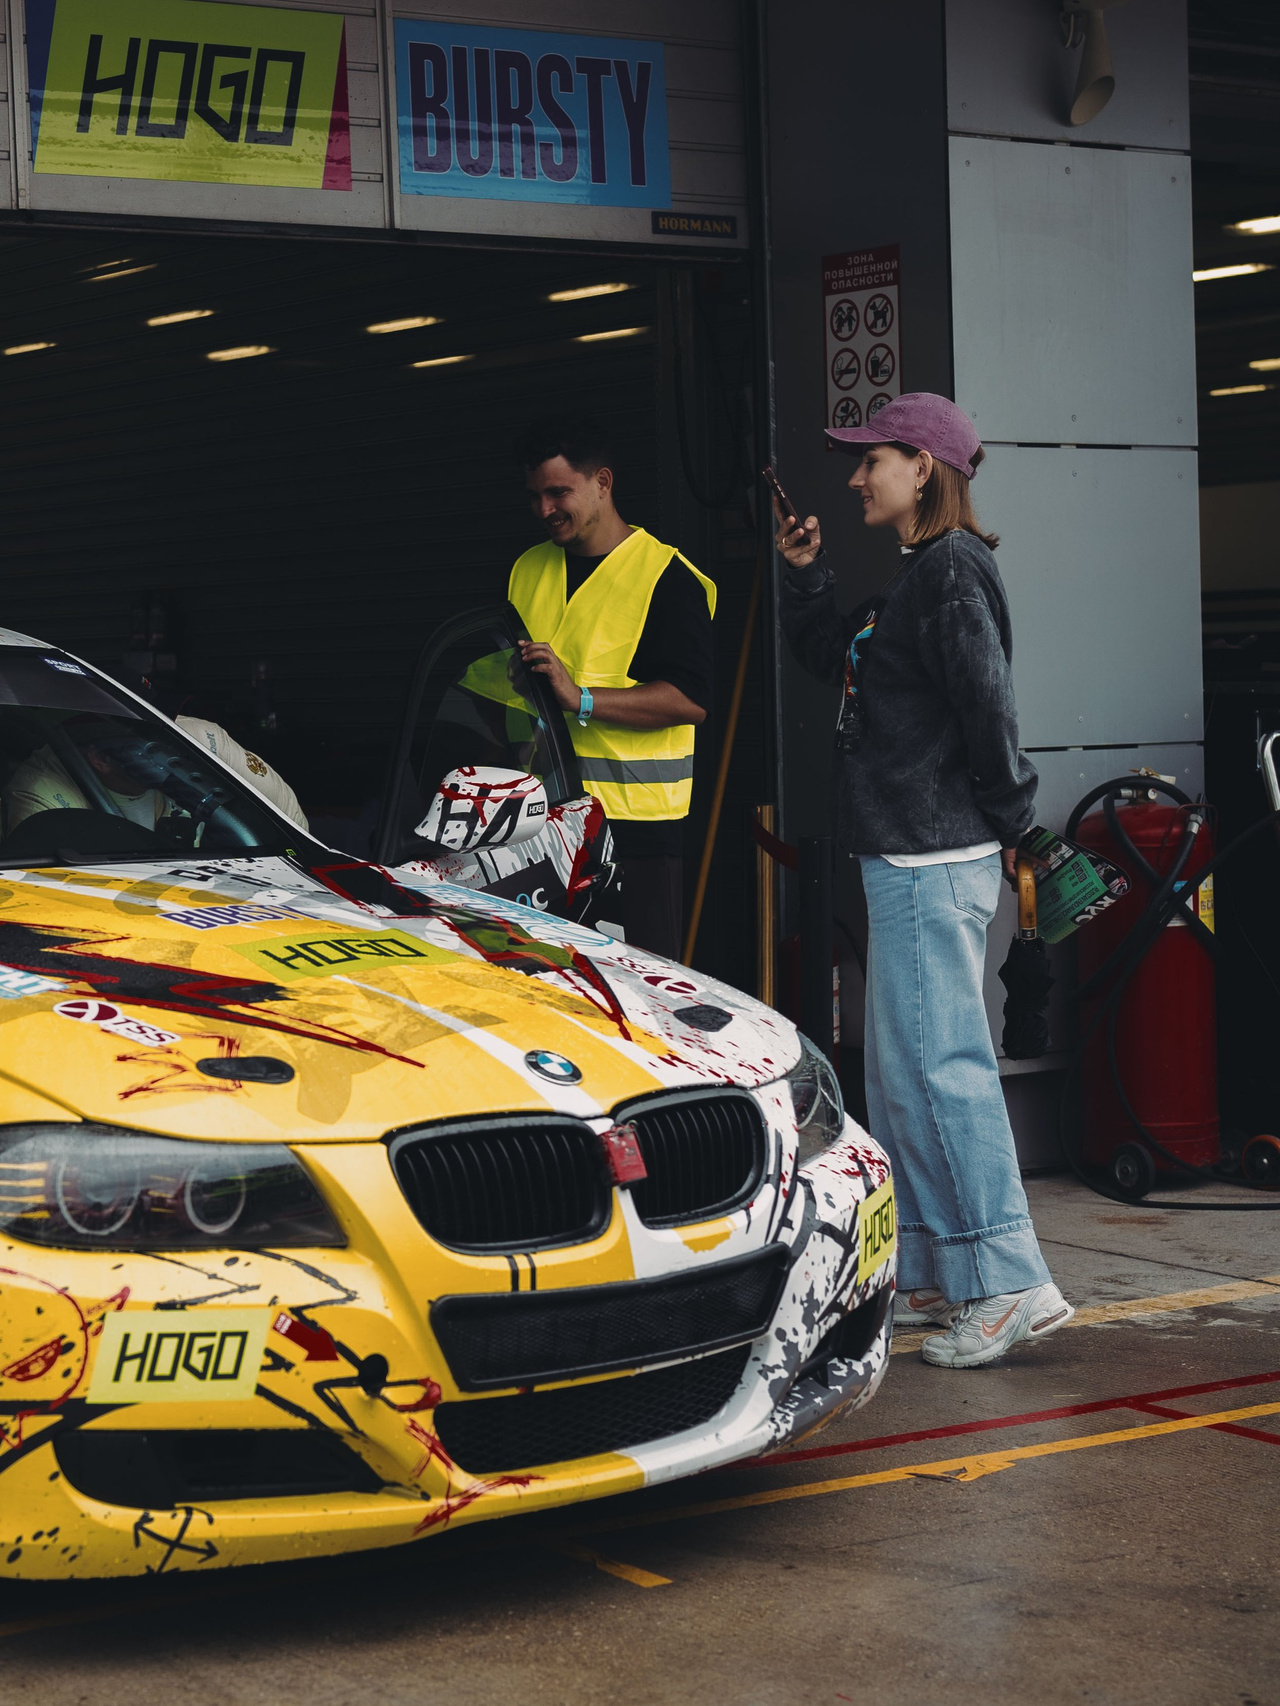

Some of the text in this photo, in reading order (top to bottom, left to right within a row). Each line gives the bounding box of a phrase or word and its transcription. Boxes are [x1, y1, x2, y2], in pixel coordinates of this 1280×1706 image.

[76, 34, 306, 146] HOGO
[407, 41, 653, 187] BURSTY
[824, 258, 898, 280] ПОВЫШЕННОЙ
[847, 253, 874, 266] ЗОНА
[831, 273, 894, 290] ОПАСНОСТИ
[158, 904, 322, 929] BURSTY
[259, 937, 429, 971] HOGO
[112, 1017, 175, 1043] TSS
[864, 1195, 893, 1263] HOGO
[112, 1331, 249, 1382] HOGO
